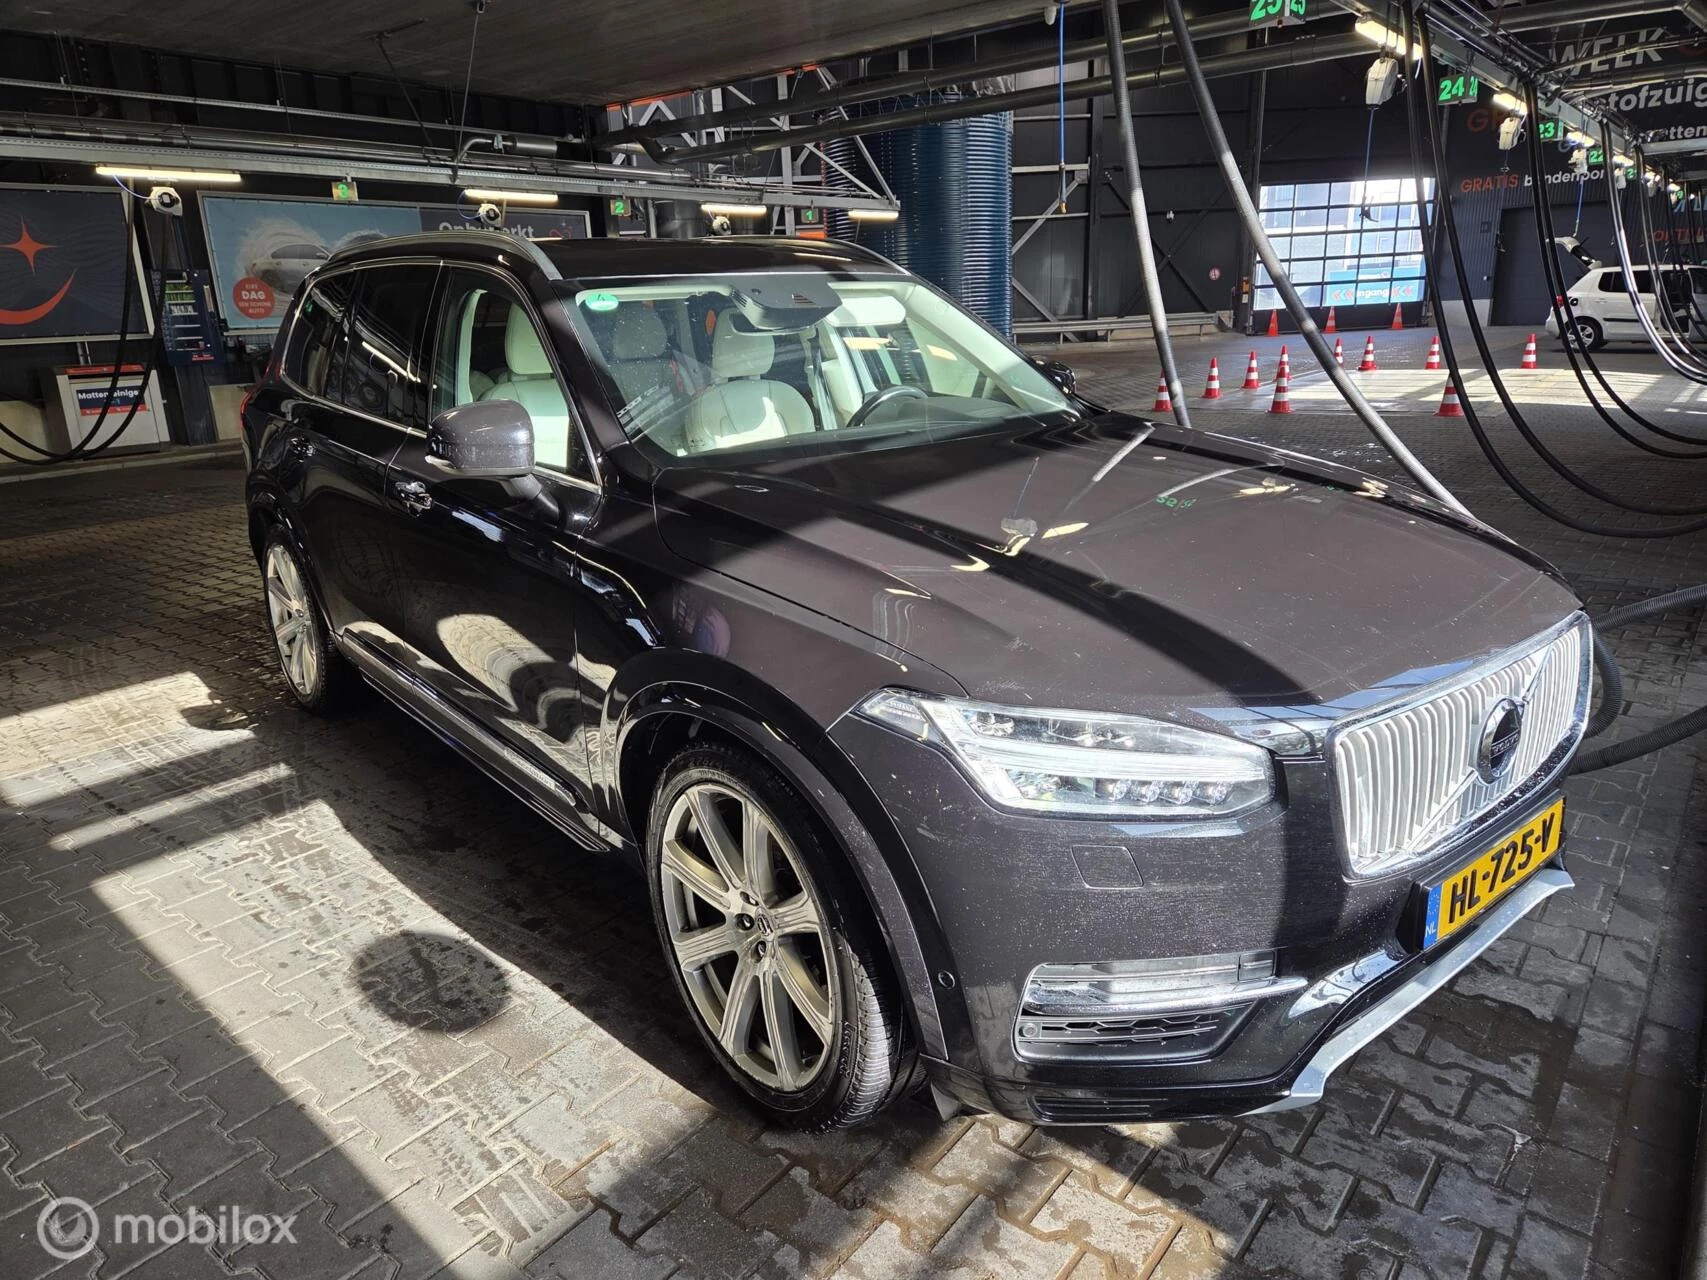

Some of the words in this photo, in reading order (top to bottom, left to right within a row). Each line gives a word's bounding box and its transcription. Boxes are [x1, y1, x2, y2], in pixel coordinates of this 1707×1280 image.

[1439, 76, 1465, 101] 24
[337, 183, 349, 199] 3
[1460, 174, 1519, 193] GRATIS
[615, 201, 624, 214] 2
[806, 210, 814, 221] 1
[241, 291, 265, 300] DAG
[1448, 812, 1556, 924] HL-725-V
[1424, 924, 1437, 939] NL
